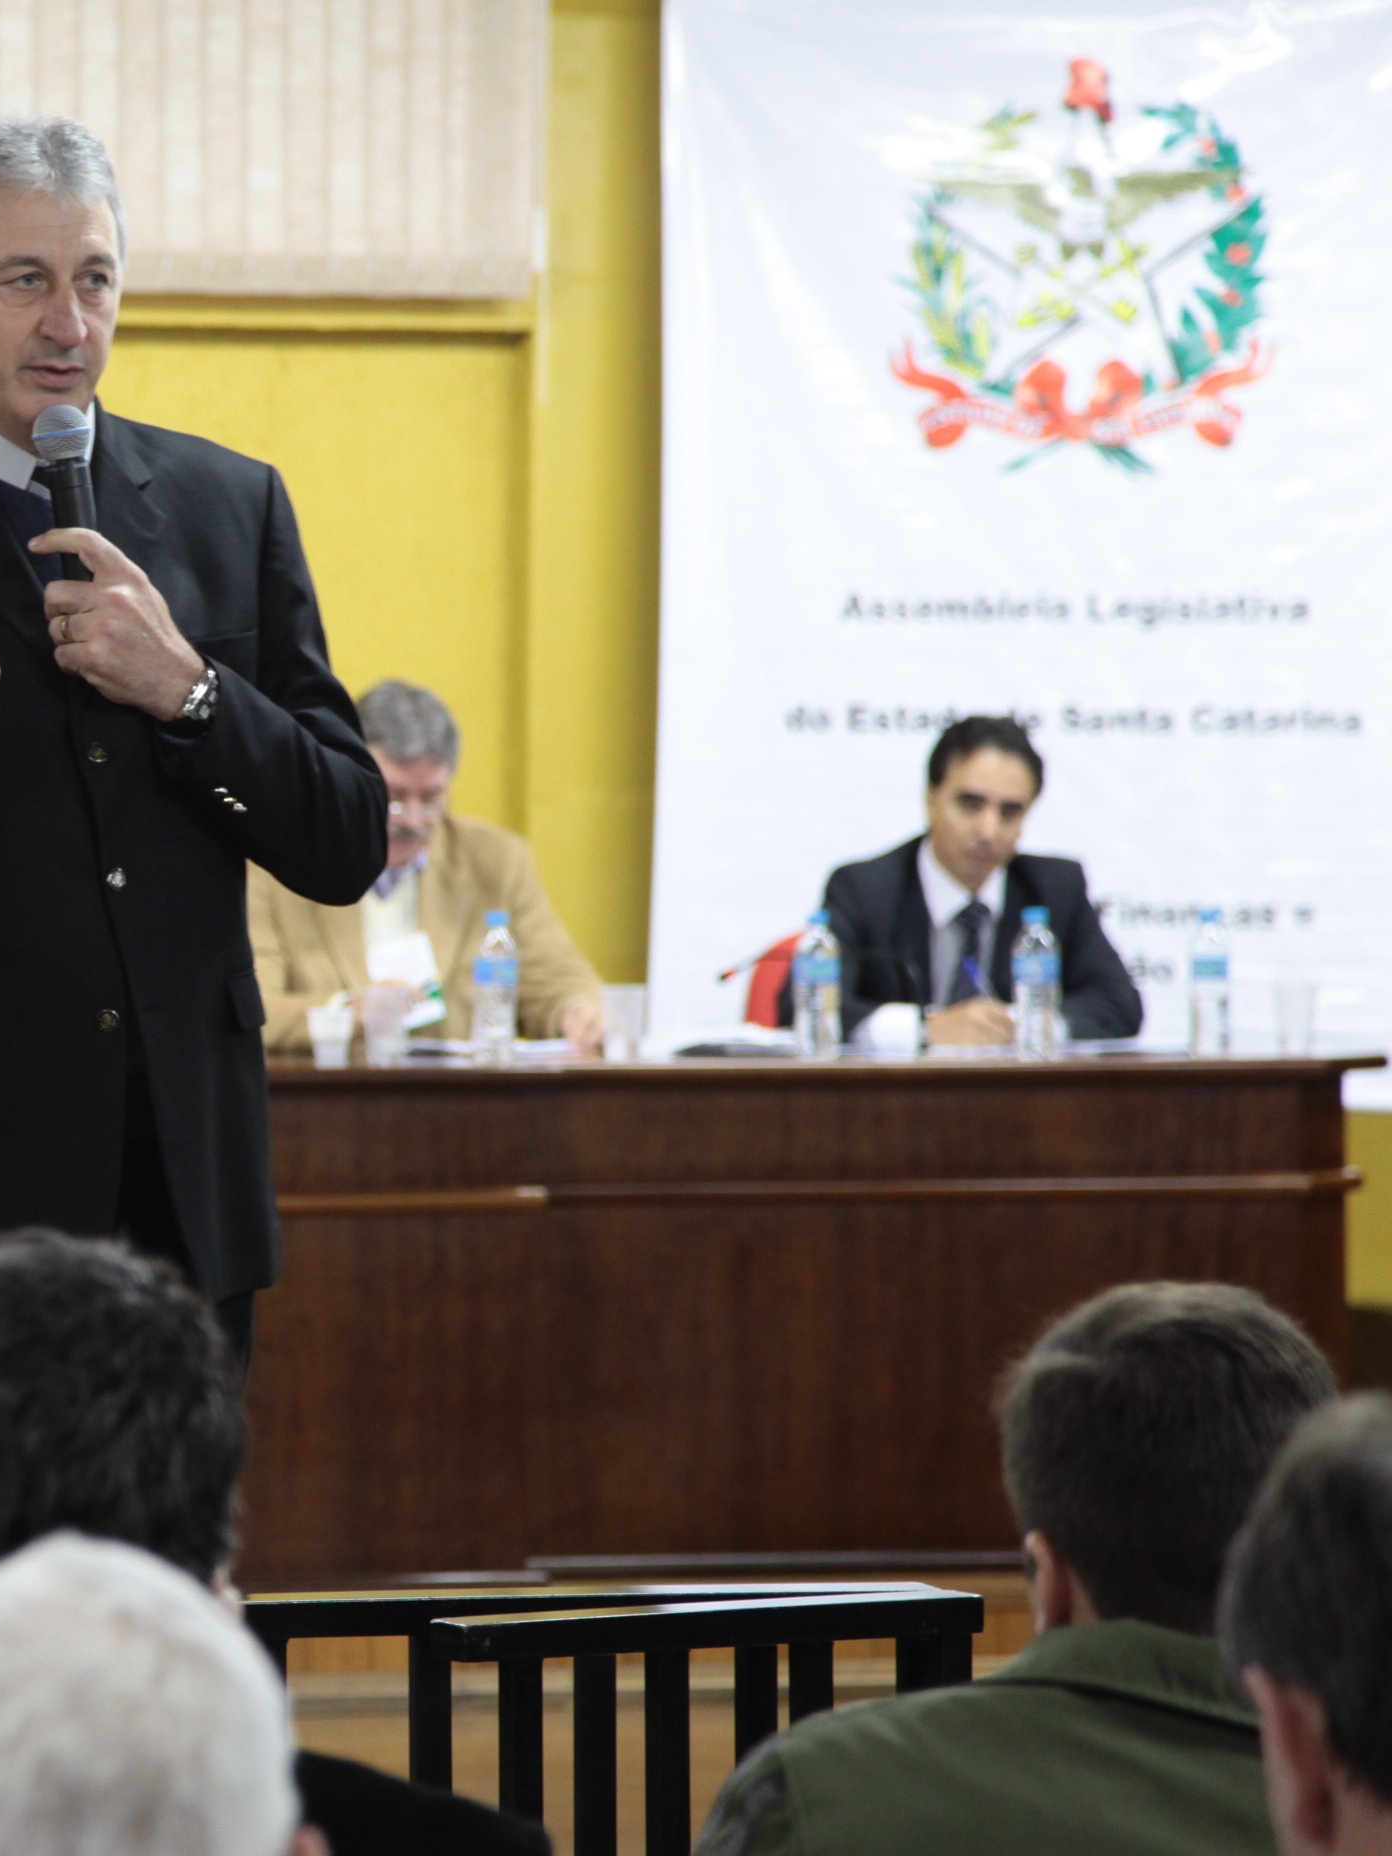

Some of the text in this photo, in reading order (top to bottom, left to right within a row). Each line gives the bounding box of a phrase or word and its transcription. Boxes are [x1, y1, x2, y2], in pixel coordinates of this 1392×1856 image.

[1086, 592, 1310, 632] Legislativa
[786, 703, 831, 734] do
[1059, 704, 1174, 735] Santa
[1190, 704, 1363, 735] Catarina
